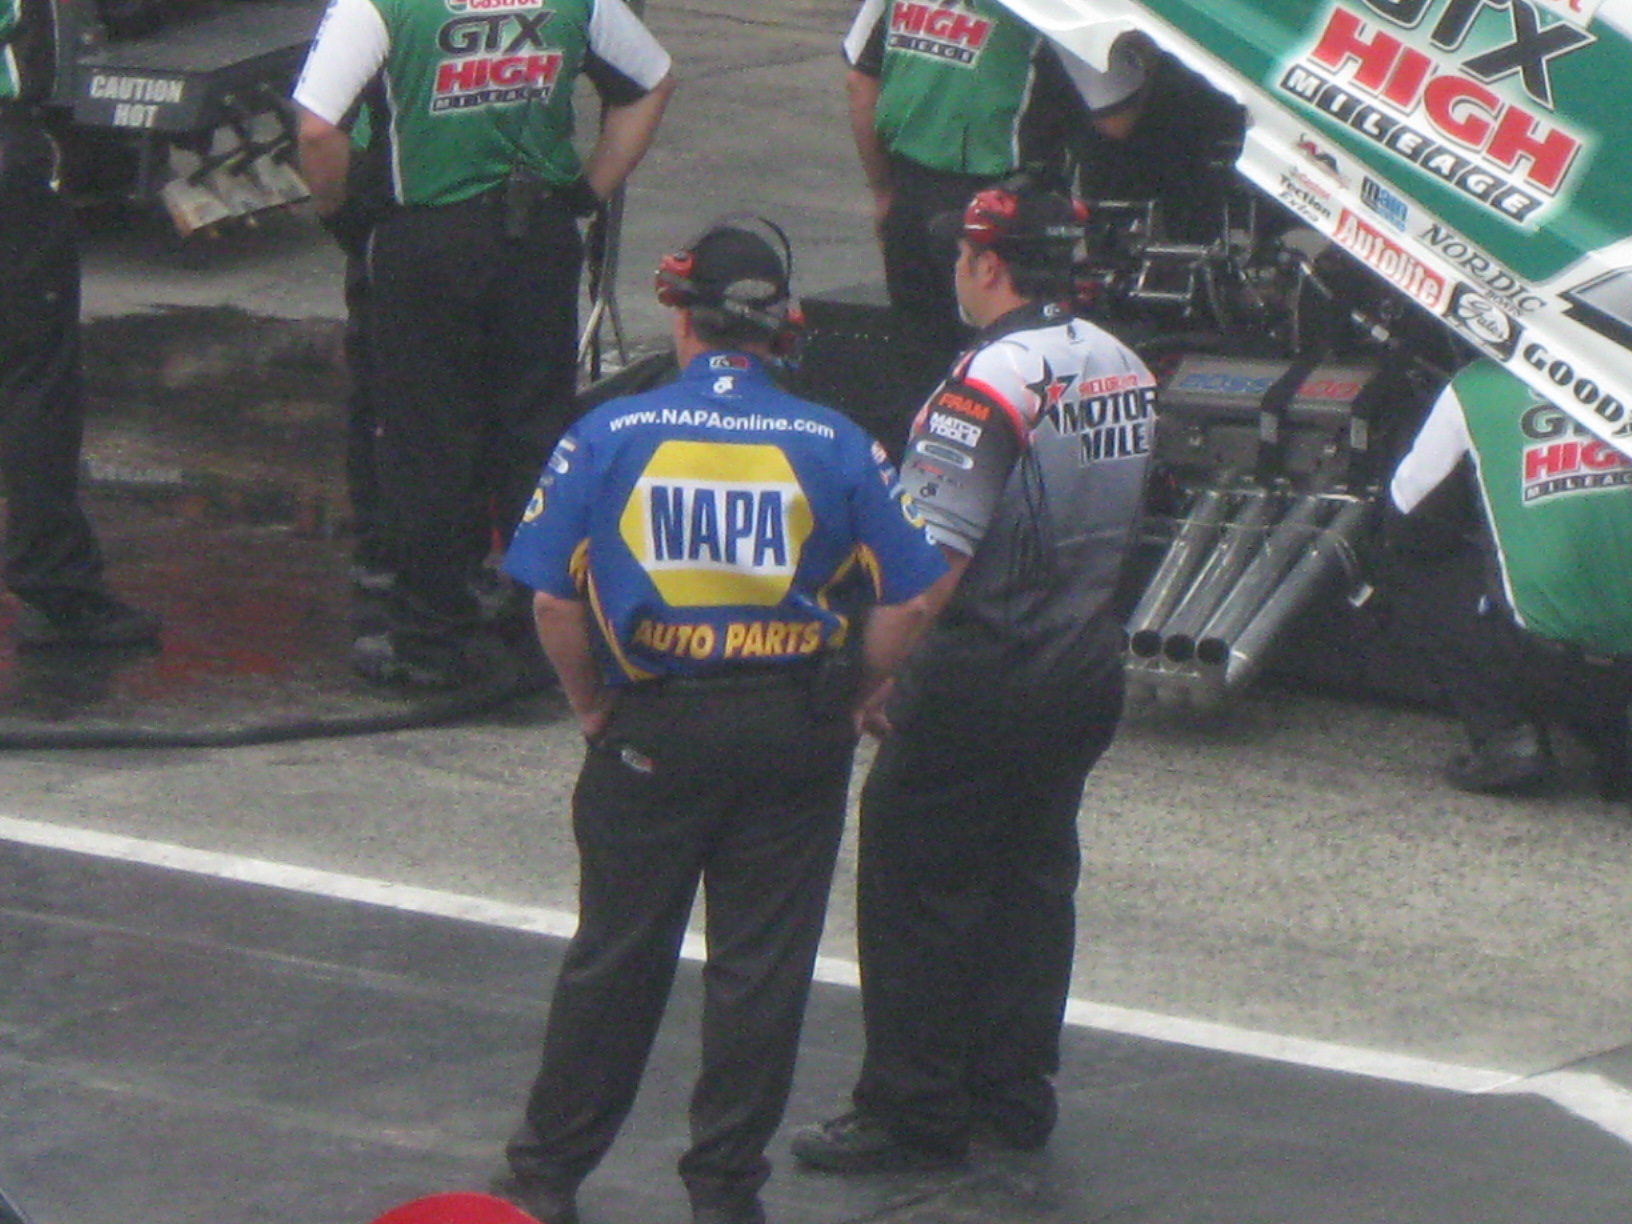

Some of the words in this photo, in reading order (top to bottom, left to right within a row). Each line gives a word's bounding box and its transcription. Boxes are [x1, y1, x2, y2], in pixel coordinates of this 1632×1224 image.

[437, 10, 557, 55] GTX
[890, 0, 993, 47] HIGH
[89, 75, 186, 103] CAUTION
[436, 54, 563, 95] HIGH
[113, 102, 159, 129] HOT
[1309, 6, 1580, 194] HIGH
[1283, 65, 1541, 221] MILEAGE
[1279, 173, 1332, 219] Tection
[1340, 214, 1440, 308] Autolite
[1420, 222, 1549, 314] NORDIC
[609, 408, 835, 440] www.NAPAonline.com
[938, 392, 992, 422] FRAM
[1060, 387, 1158, 435] MOTOR
[1081, 422, 1150, 466] MILE
[650, 485, 787, 569] NAPA
[630, 619, 714, 659] AUTO
[723, 619, 822, 658] PARTS
